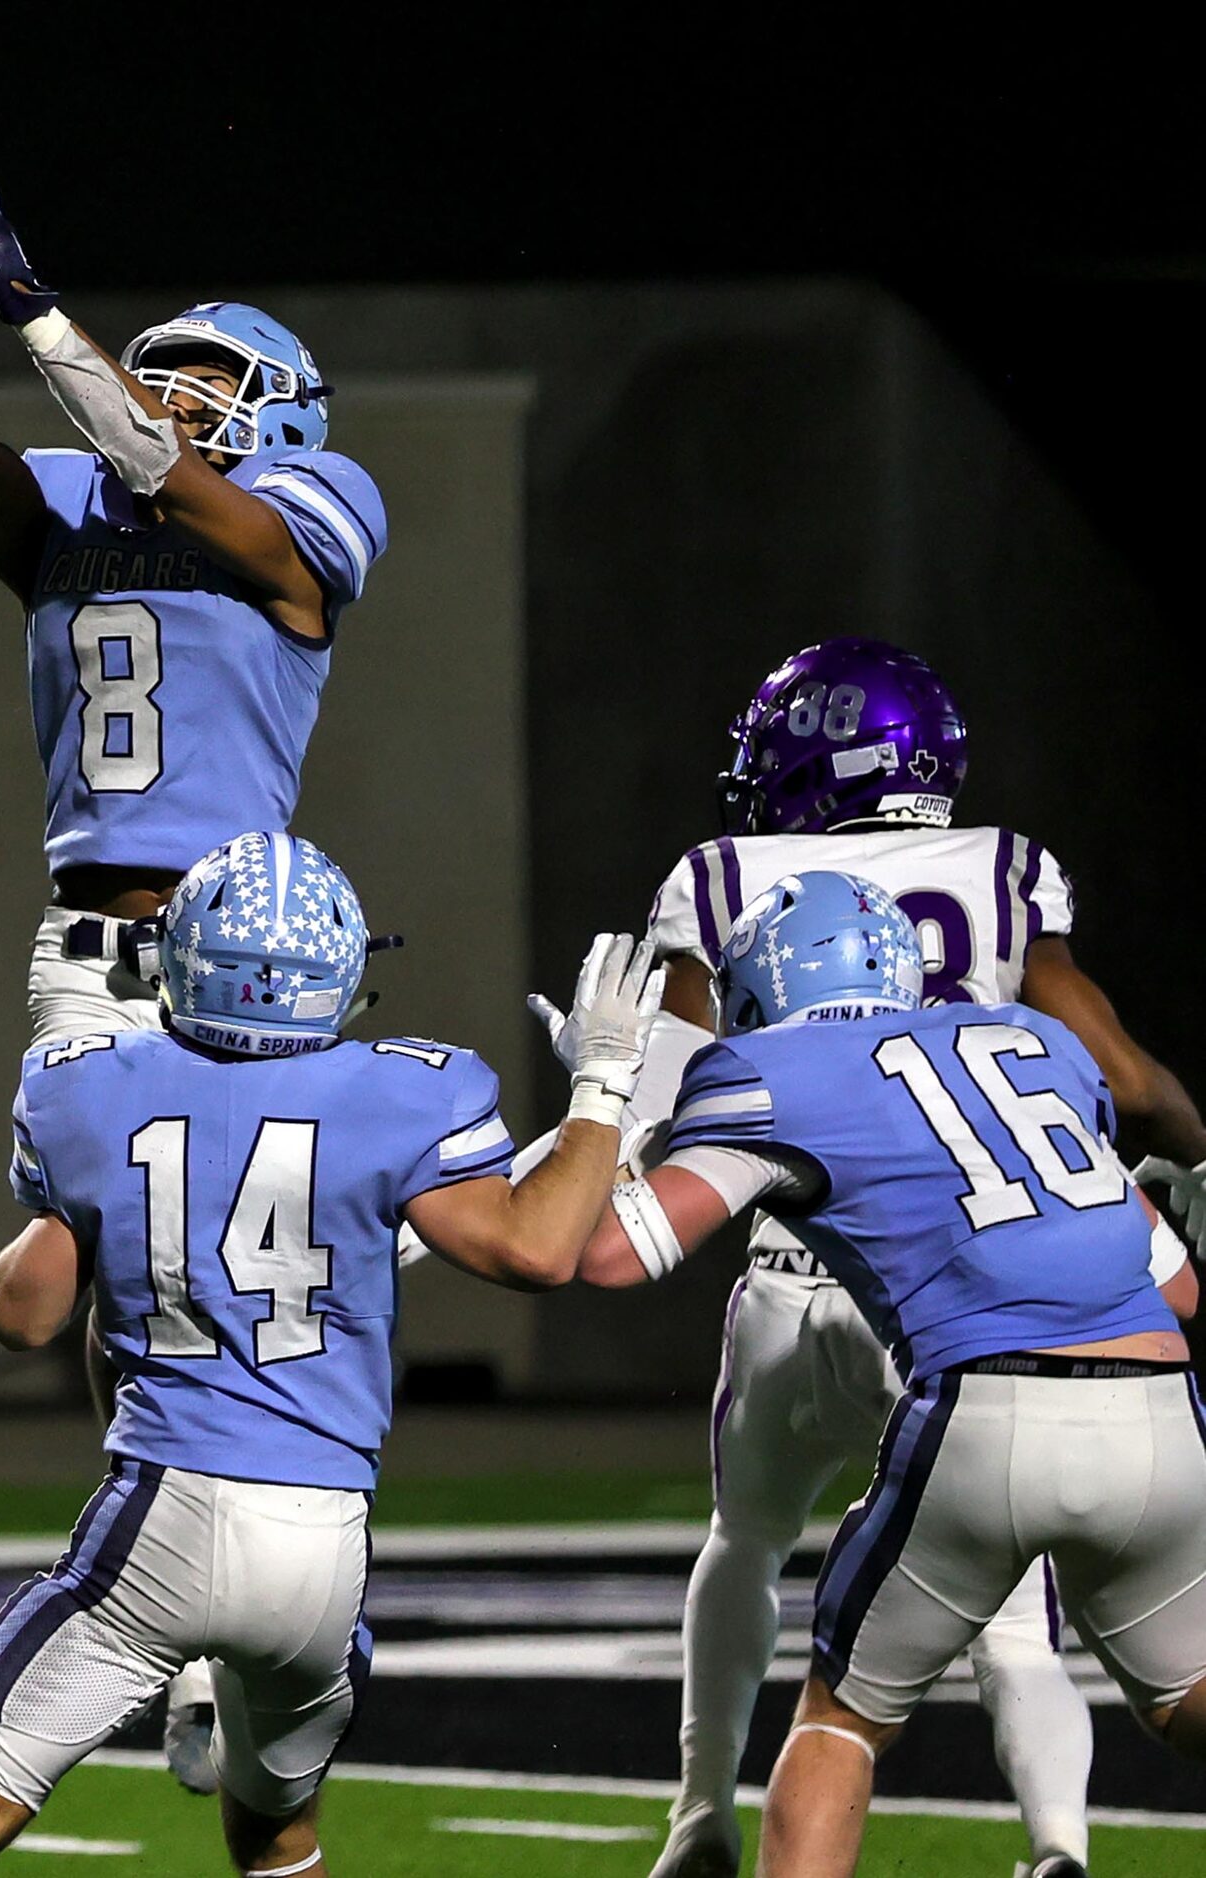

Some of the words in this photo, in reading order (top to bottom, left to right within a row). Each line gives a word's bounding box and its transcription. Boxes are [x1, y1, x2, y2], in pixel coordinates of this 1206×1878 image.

[67, 599, 164, 795] 8
[787, 677, 866, 743] 88
[195, 1024, 251, 1051] CHINA
[259, 1037, 323, 1055] SPRING
[807, 1006, 863, 1023] CHINA
[871, 1023, 1128, 1232] 16
[127, 1115, 334, 1368] 14
